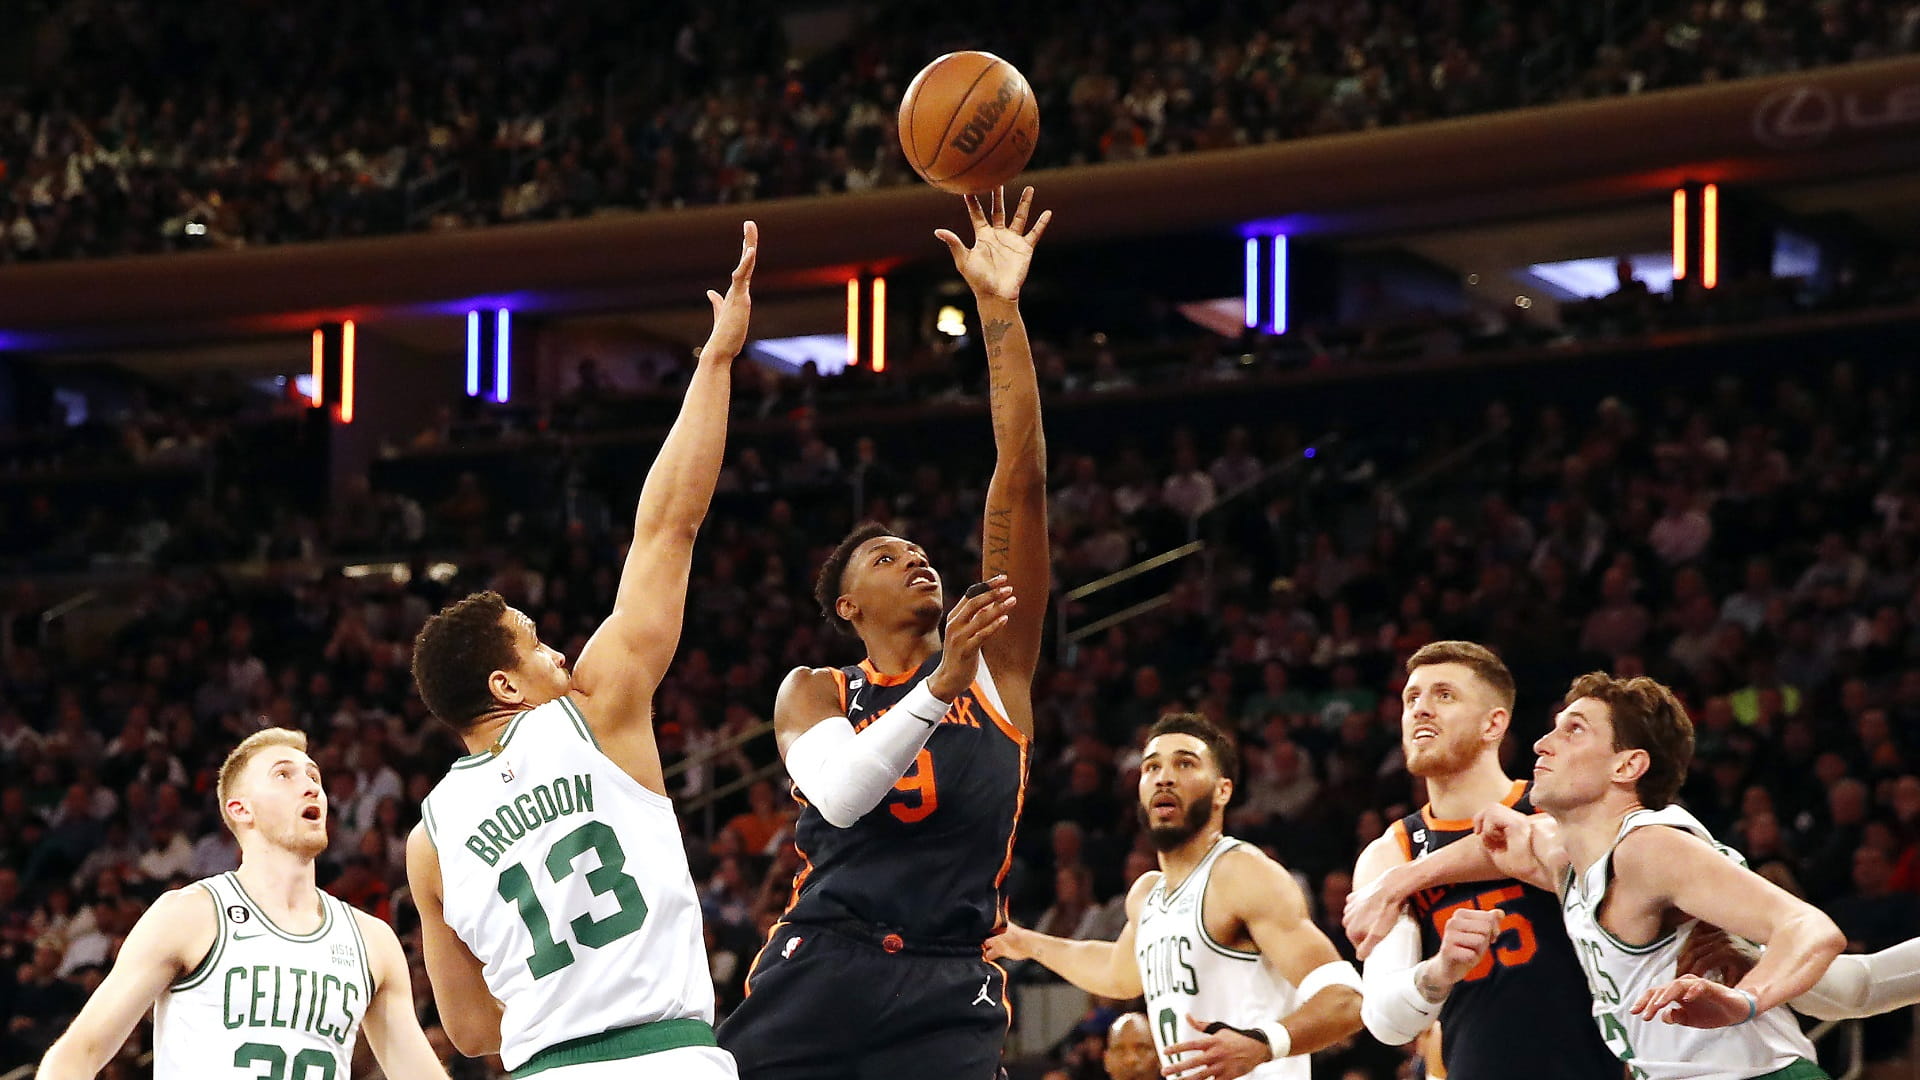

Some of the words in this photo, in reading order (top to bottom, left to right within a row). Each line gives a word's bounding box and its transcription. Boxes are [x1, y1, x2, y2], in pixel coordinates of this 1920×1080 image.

[465, 773, 594, 867] BROGDON
[890, 747, 938, 823] 9
[229, 906, 248, 923] 6
[498, 820, 648, 980] 13
[224, 965, 358, 1045] CELTICS
